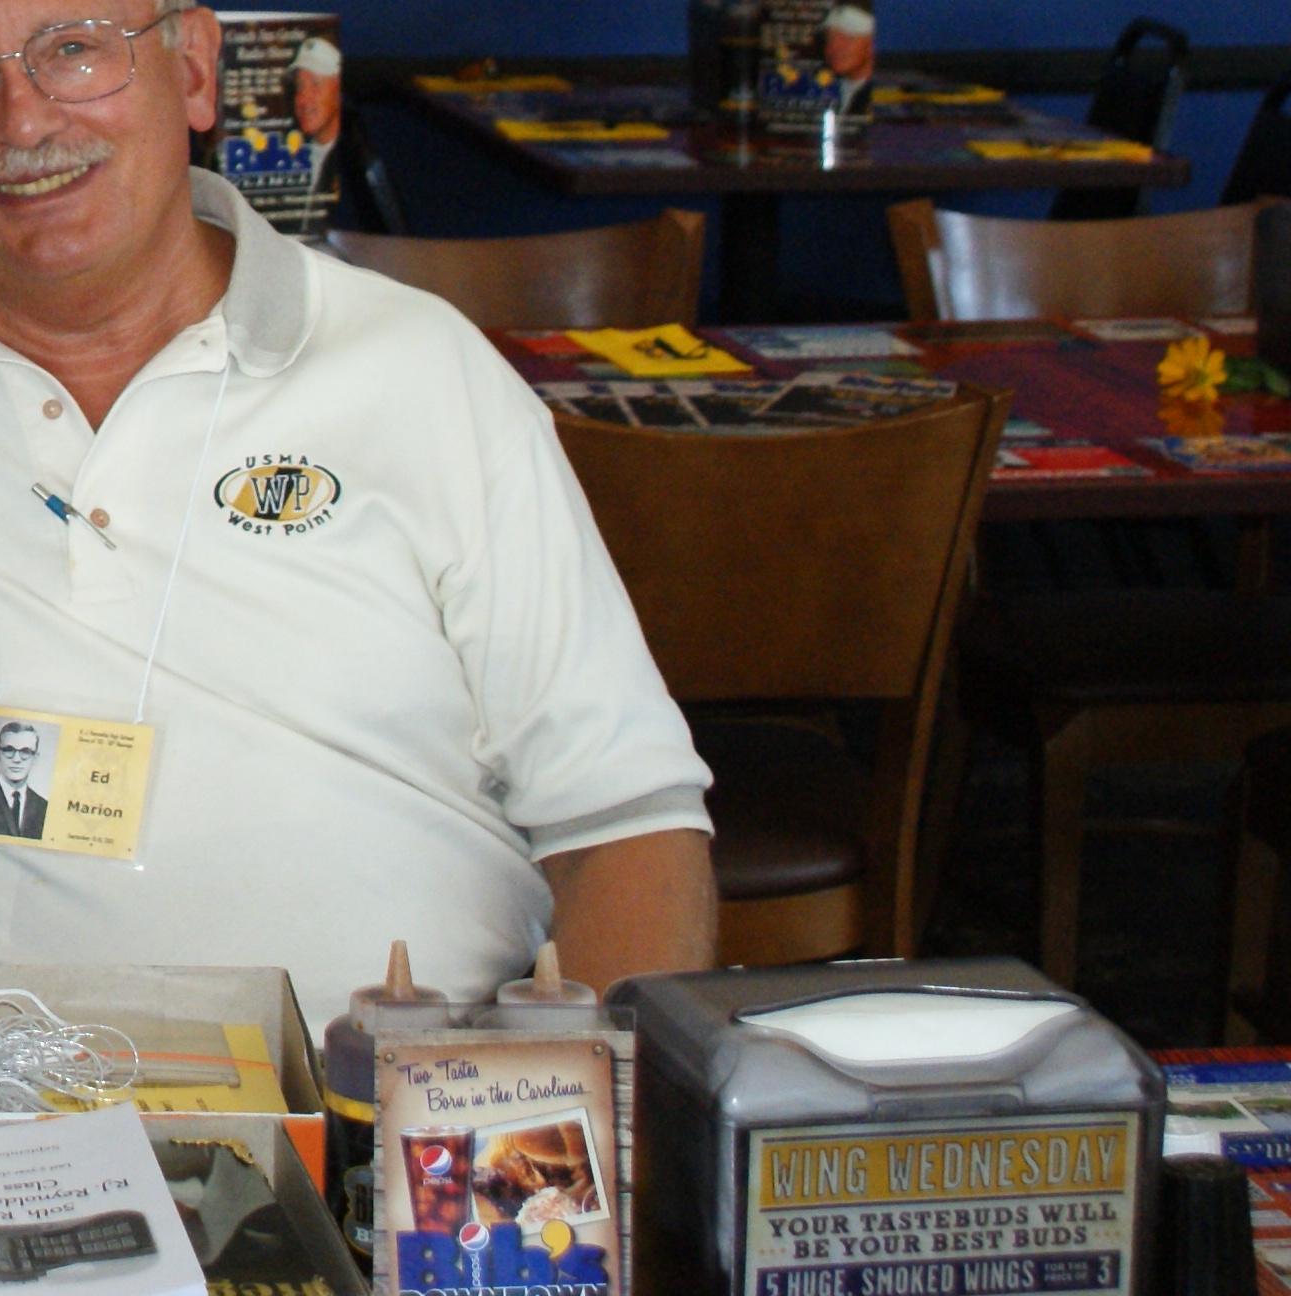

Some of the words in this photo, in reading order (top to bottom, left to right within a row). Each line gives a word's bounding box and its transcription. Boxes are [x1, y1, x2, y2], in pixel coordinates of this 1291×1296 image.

[245, 453, 309, 469] USMA
[228, 510, 273, 535] West
[282, 508, 333, 536] Point
[90, 770, 110, 784] Ed
[67, 800, 123, 818] Marion
[396, 1063, 433, 1085] Two
[435, 1058, 479, 1081] Tastes
[426, 1087, 468, 1112] Born
[470, 1087, 486, 1106] in
[487, 1082, 513, 1104] the
[770, 1147, 868, 1199] WING
[887, 1135, 1120, 1193] WEDNESDAY
[3, 1178, 59, 1192] Class
[422, 1176, 454, 1187] pepsi
[27, 1202, 75, 1219] 50th
[768, 1215, 850, 1237] YOUR
[860, 1205, 1030, 1232] TASTEBUDS
[1038, 1202, 1117, 1223] WILL
[793, 1238, 830, 1259] BE
[839, 1234, 921, 1256] YOUR
[931, 1230, 1003, 1253] BEST
[1013, 1225, 1087, 1249] BUDS
[766, 1272, 780, 1296] 5
[861, 1263, 954, 1296] SMOKED
[964, 1259, 1036, 1292] WINGS
[1097, 1255, 1112, 1285] 3
